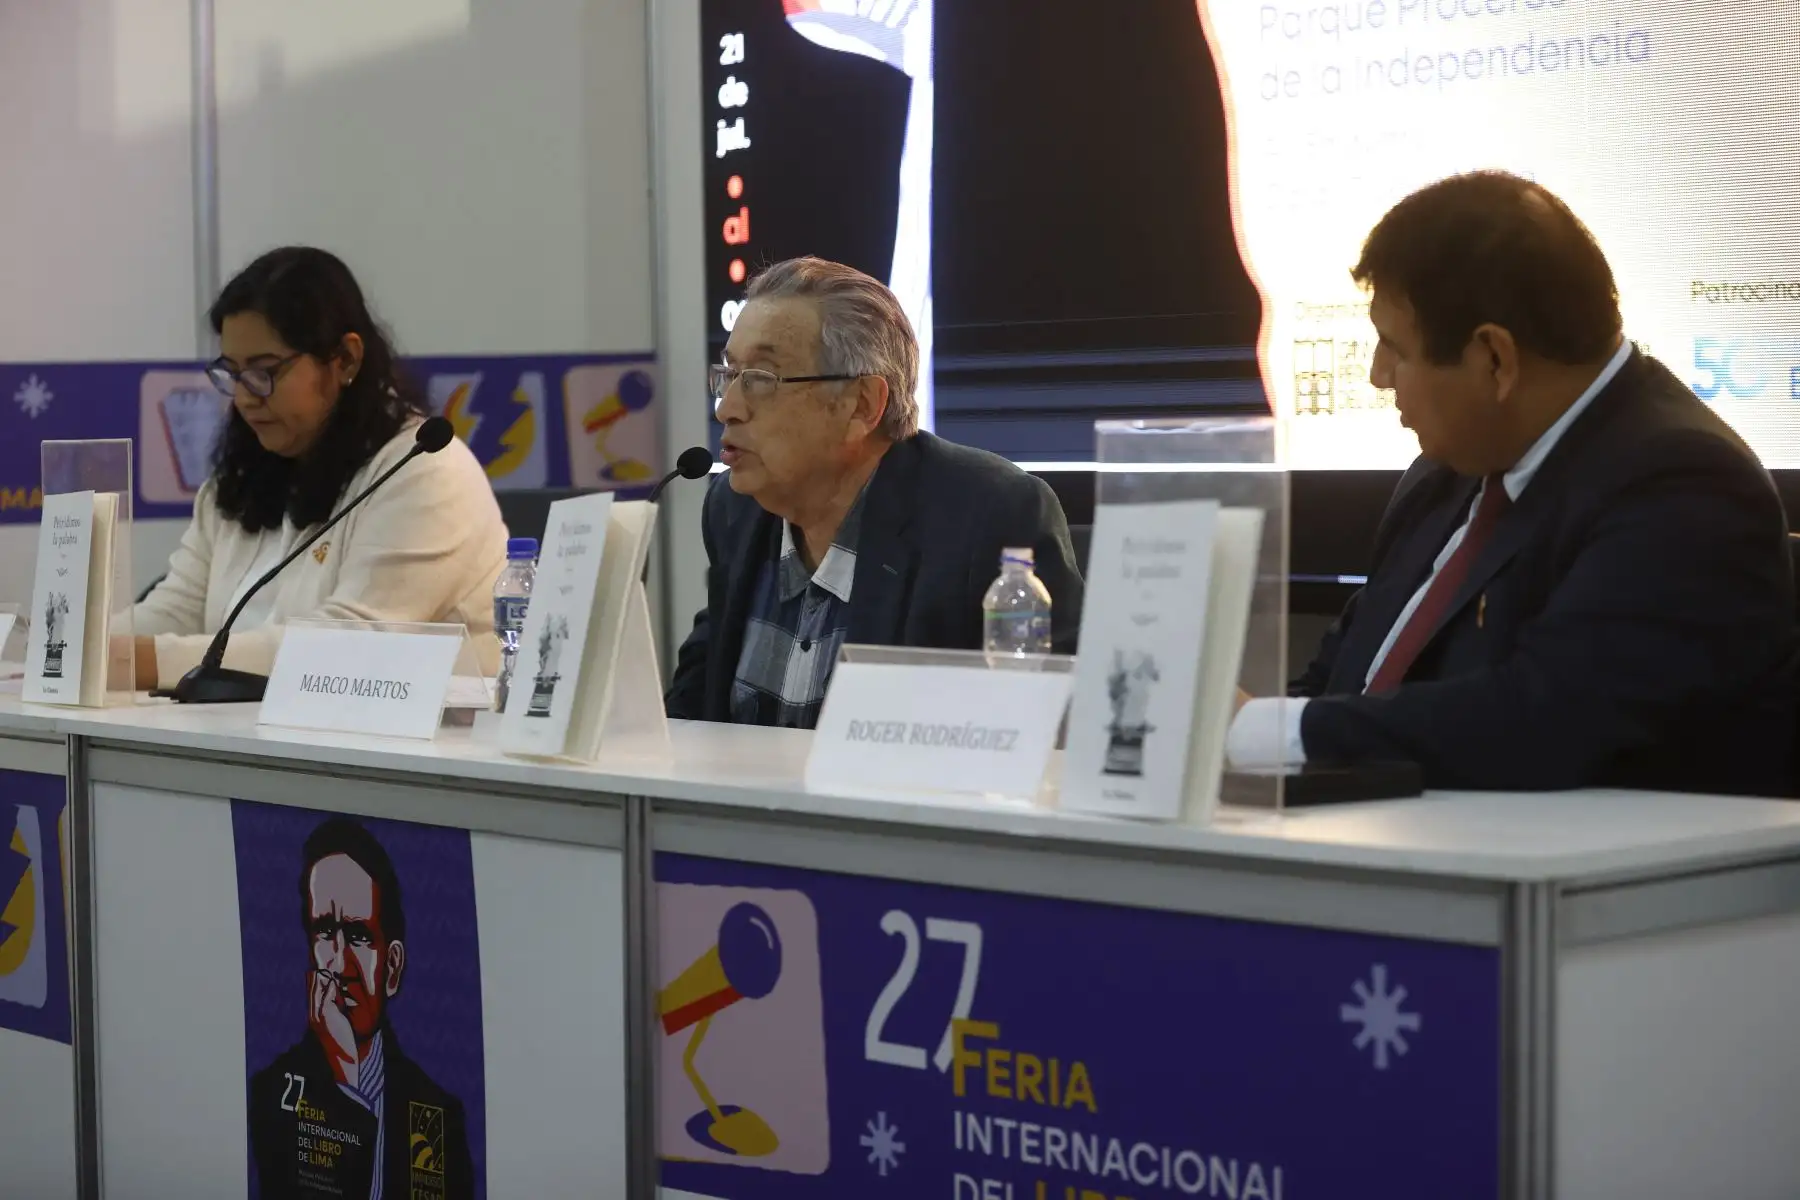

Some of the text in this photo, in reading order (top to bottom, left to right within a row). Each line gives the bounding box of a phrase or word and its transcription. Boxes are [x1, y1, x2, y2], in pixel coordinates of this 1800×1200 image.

[1259, 0, 1388, 43] Parque
[1259, 61, 1302, 103] de
[1355, 19, 1653, 94] Independencia
[299, 673, 411, 700] MARCO MARTOS
[846, 719, 1021, 752] ROGER RODRÍGUEZ
[864, 909, 983, 1074] 27
[951, 1017, 1098, 1113] FERIA
[280, 1072, 305, 1112] 27
[299, 1099, 326, 1122] FERIA
[298, 1121, 361, 1146] INTERNACIONAL
[298, 1136, 342, 1156] DEL LIBRO
[298, 1151, 334, 1169] DE LIMA
